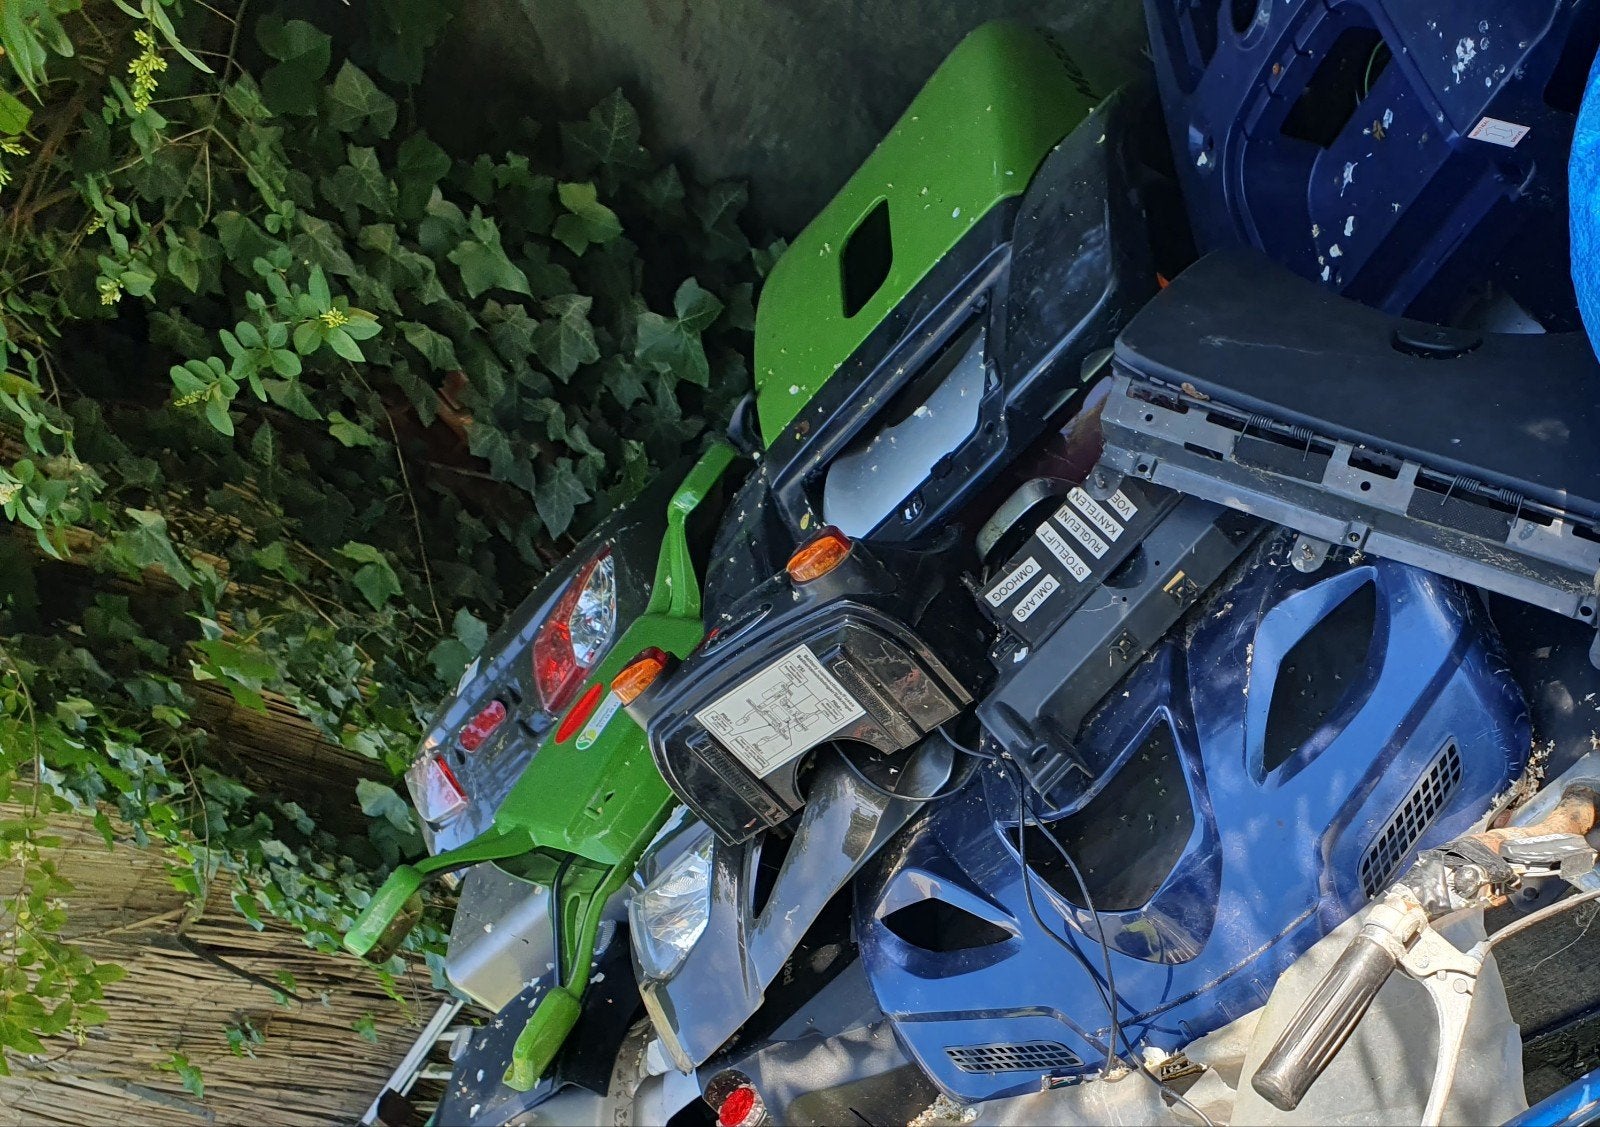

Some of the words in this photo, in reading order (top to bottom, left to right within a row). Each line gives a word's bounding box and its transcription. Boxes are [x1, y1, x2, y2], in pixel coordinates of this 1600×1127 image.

[1072, 490, 1118, 536] KANTELEN
[1040, 529, 1085, 576] STOELLIFT
[991, 564, 1034, 601] OMHOOG
[1015, 580, 1053, 618] OMLAAG
